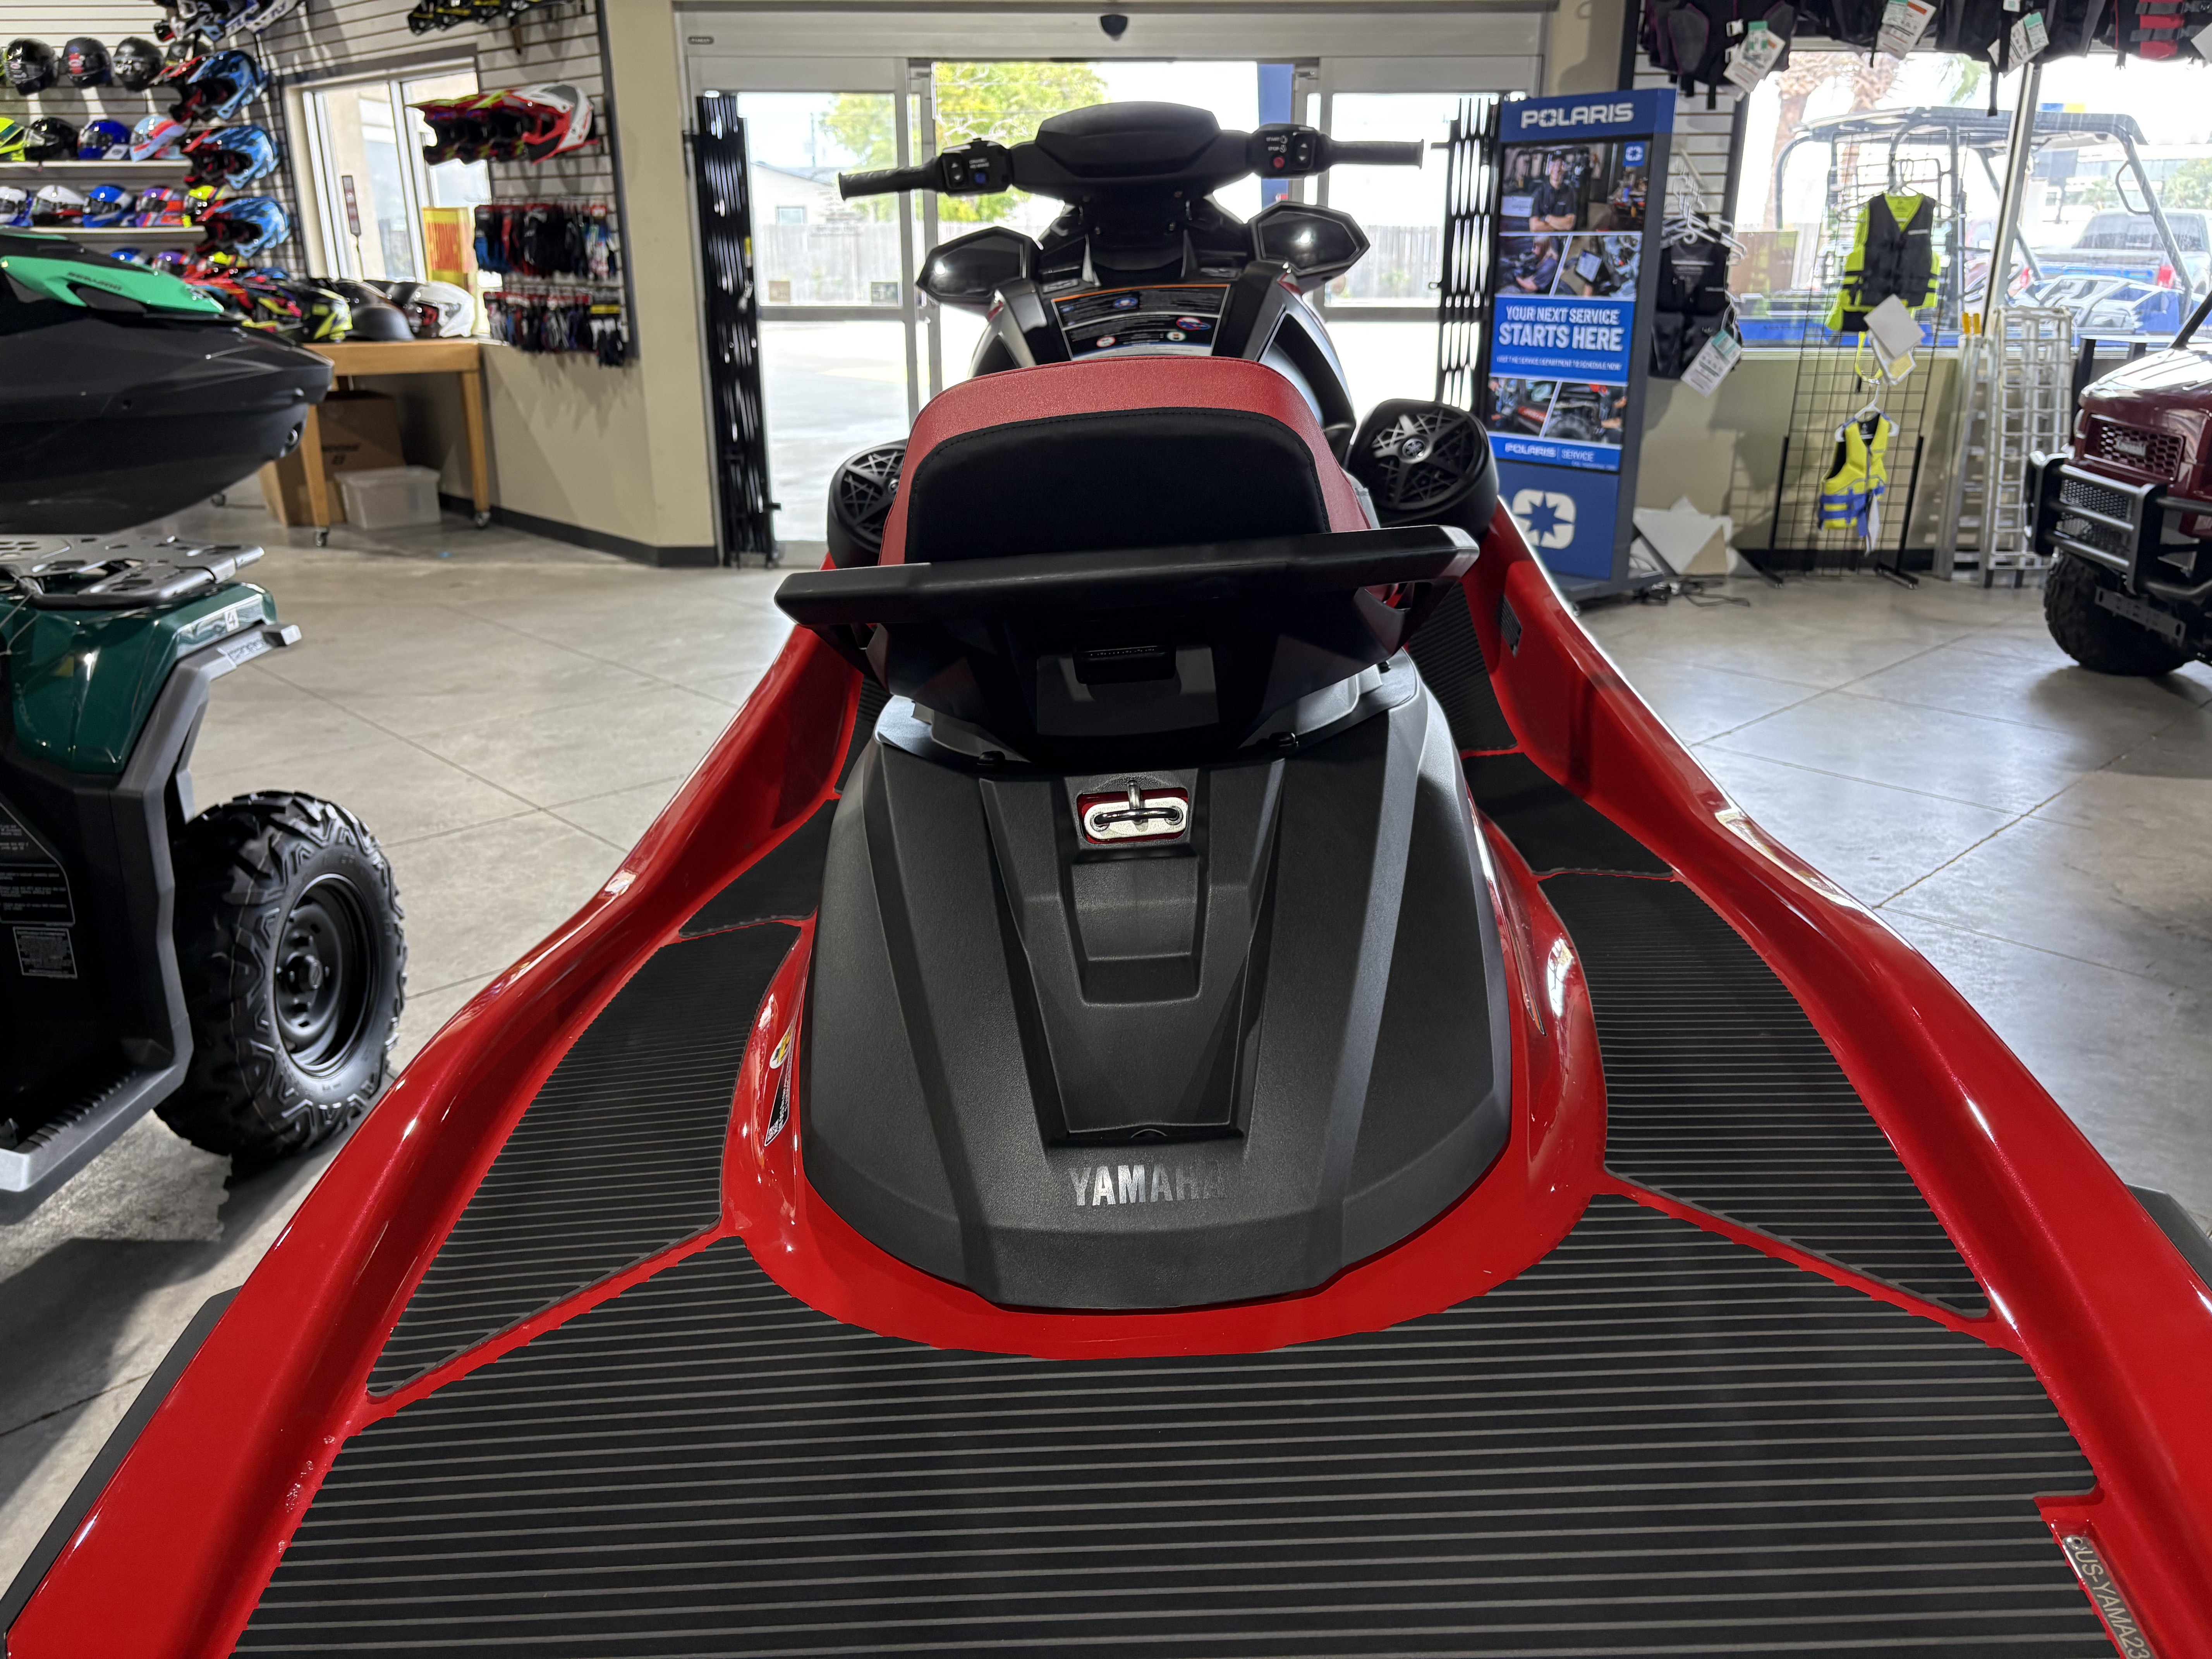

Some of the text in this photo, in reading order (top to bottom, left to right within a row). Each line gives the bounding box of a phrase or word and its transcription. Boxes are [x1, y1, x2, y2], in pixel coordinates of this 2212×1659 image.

[1520, 102, 1634, 129] POLARIS
[1506, 306, 1621, 325] YOUR NEXT SERVICE
[1498, 321, 1625, 351] STARTS HERE
[1539, 357, 1572, 368] DEPARTMENT
[1573, 359, 1579, 368] TO
[1504, 442, 1595, 462] POLARIS SERVICE
